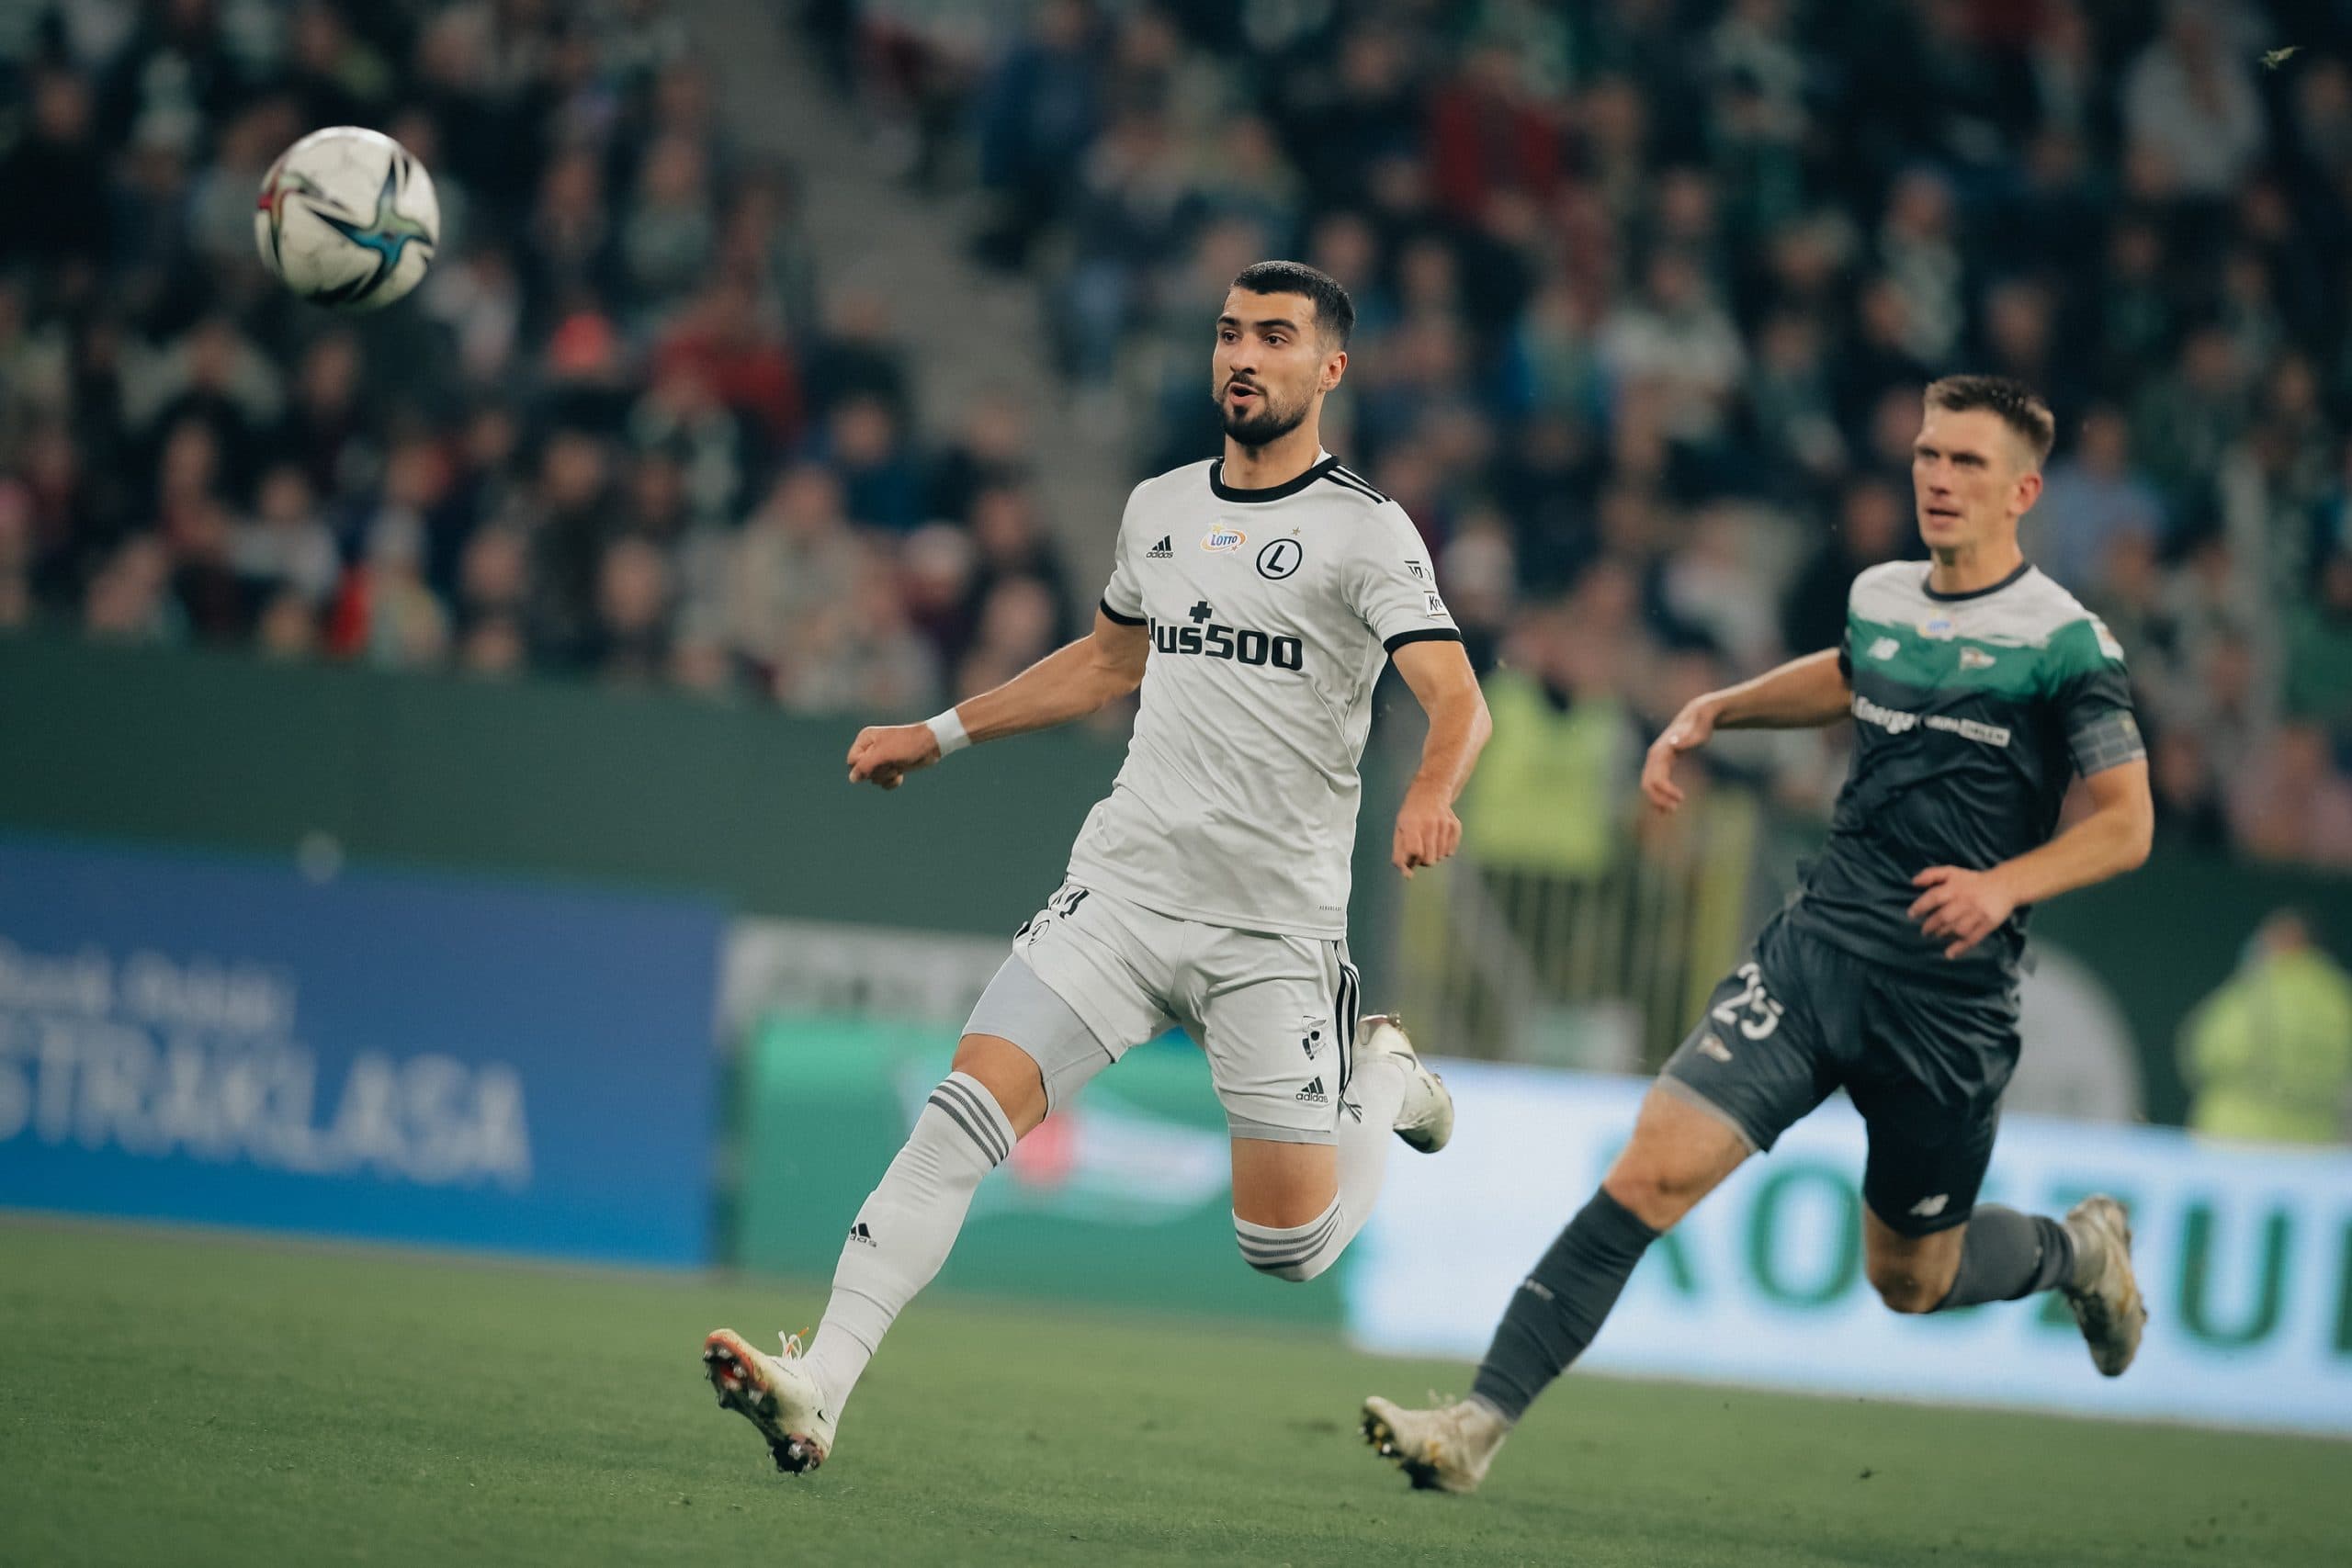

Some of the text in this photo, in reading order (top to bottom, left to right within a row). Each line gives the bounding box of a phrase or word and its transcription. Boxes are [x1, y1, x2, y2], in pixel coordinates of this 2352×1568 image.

[1146, 551, 1174, 559] adidas
[1712, 962, 1785, 1041] 25
[1295, 1093, 1329, 1103] adidas
